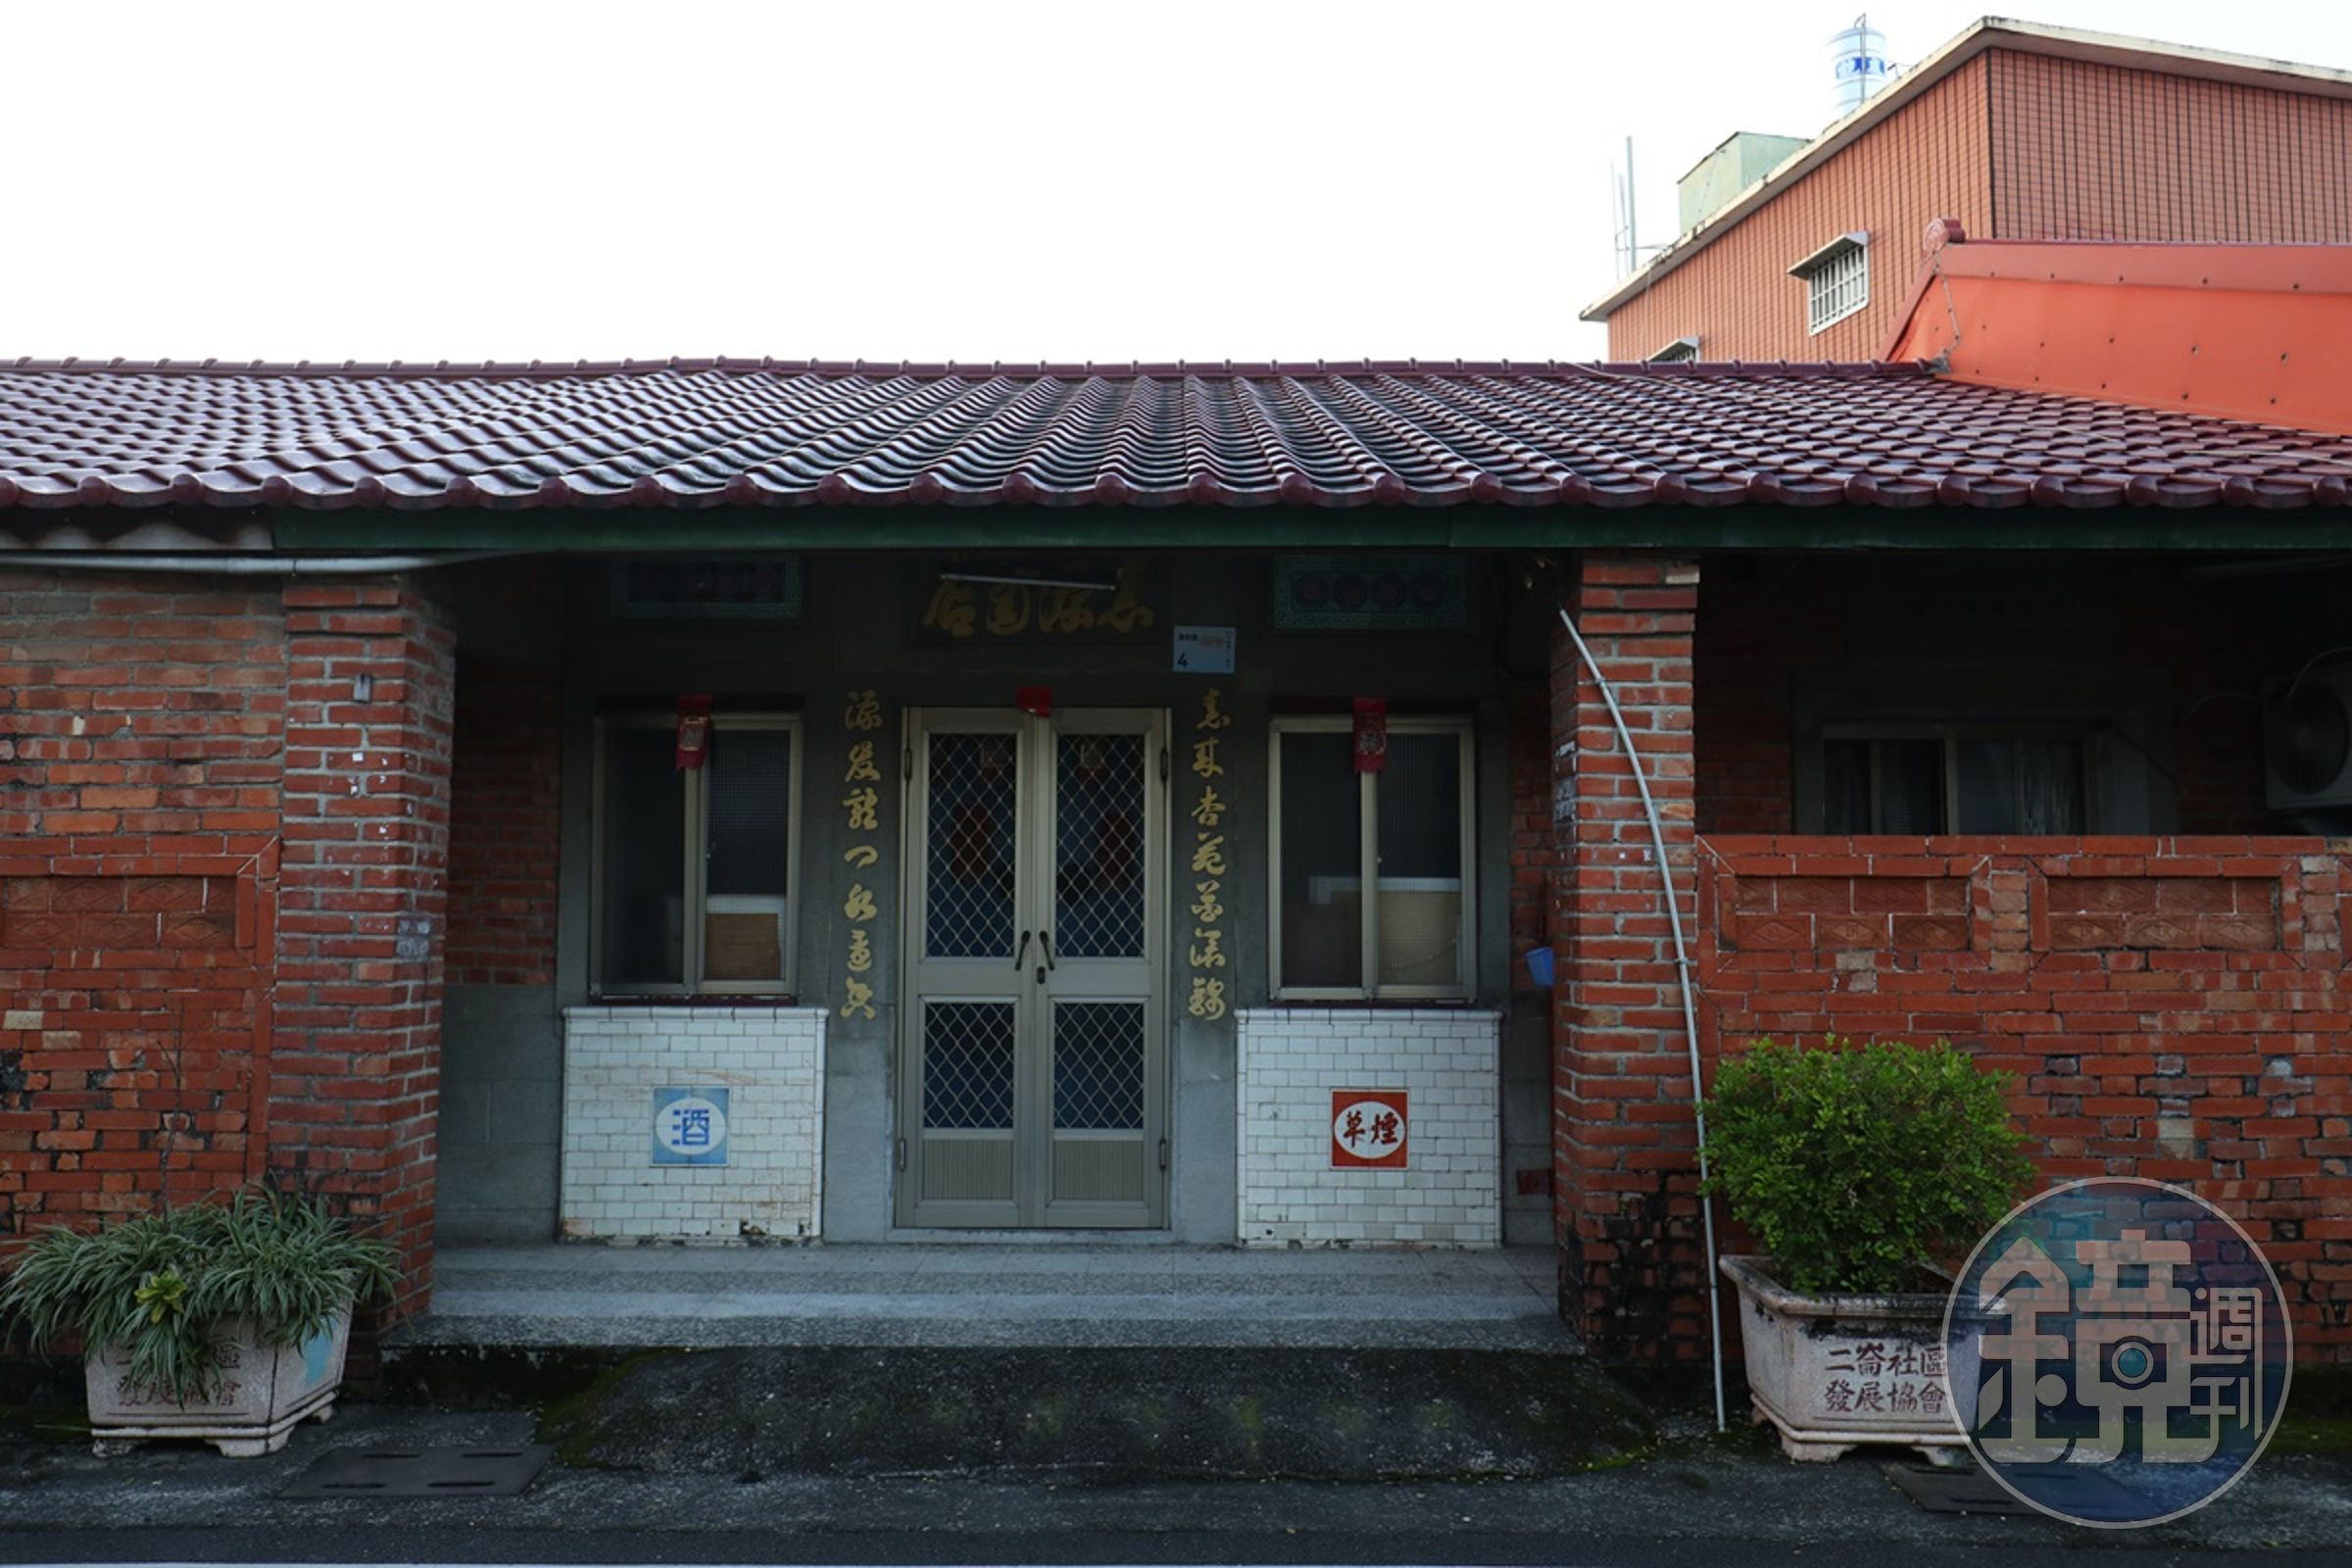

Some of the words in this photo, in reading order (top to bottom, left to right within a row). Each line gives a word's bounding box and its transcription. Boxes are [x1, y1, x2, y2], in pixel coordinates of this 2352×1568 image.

[1177, 653, 1189, 667] 4
[671, 1108, 710, 1145] 酒
[1824, 1379, 1946, 1412] 發展協會
